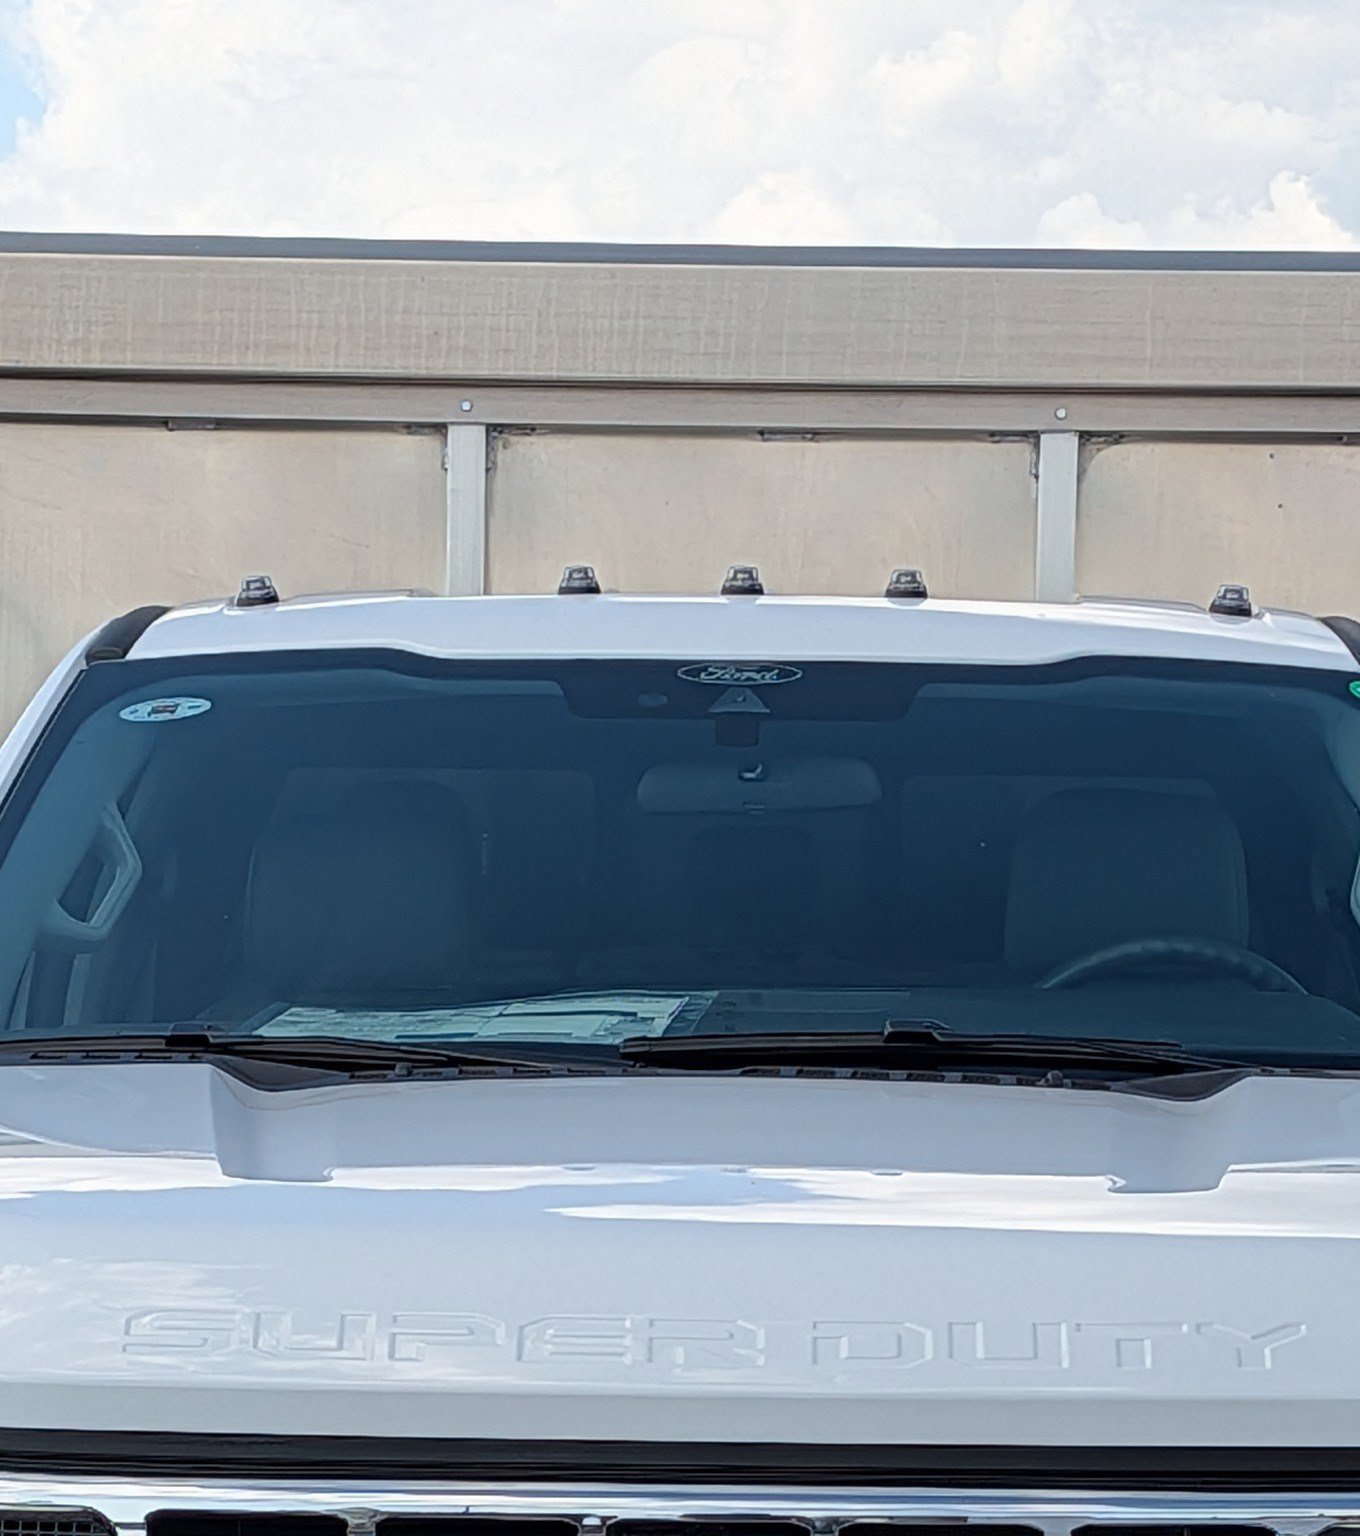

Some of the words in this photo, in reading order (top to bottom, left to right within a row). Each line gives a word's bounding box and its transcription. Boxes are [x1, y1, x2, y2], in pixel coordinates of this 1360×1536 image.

[700, 664, 779, 682] Ford
[121, 1307, 766, 1367] SUPER
[811, 1320, 1308, 1370] DUTY
